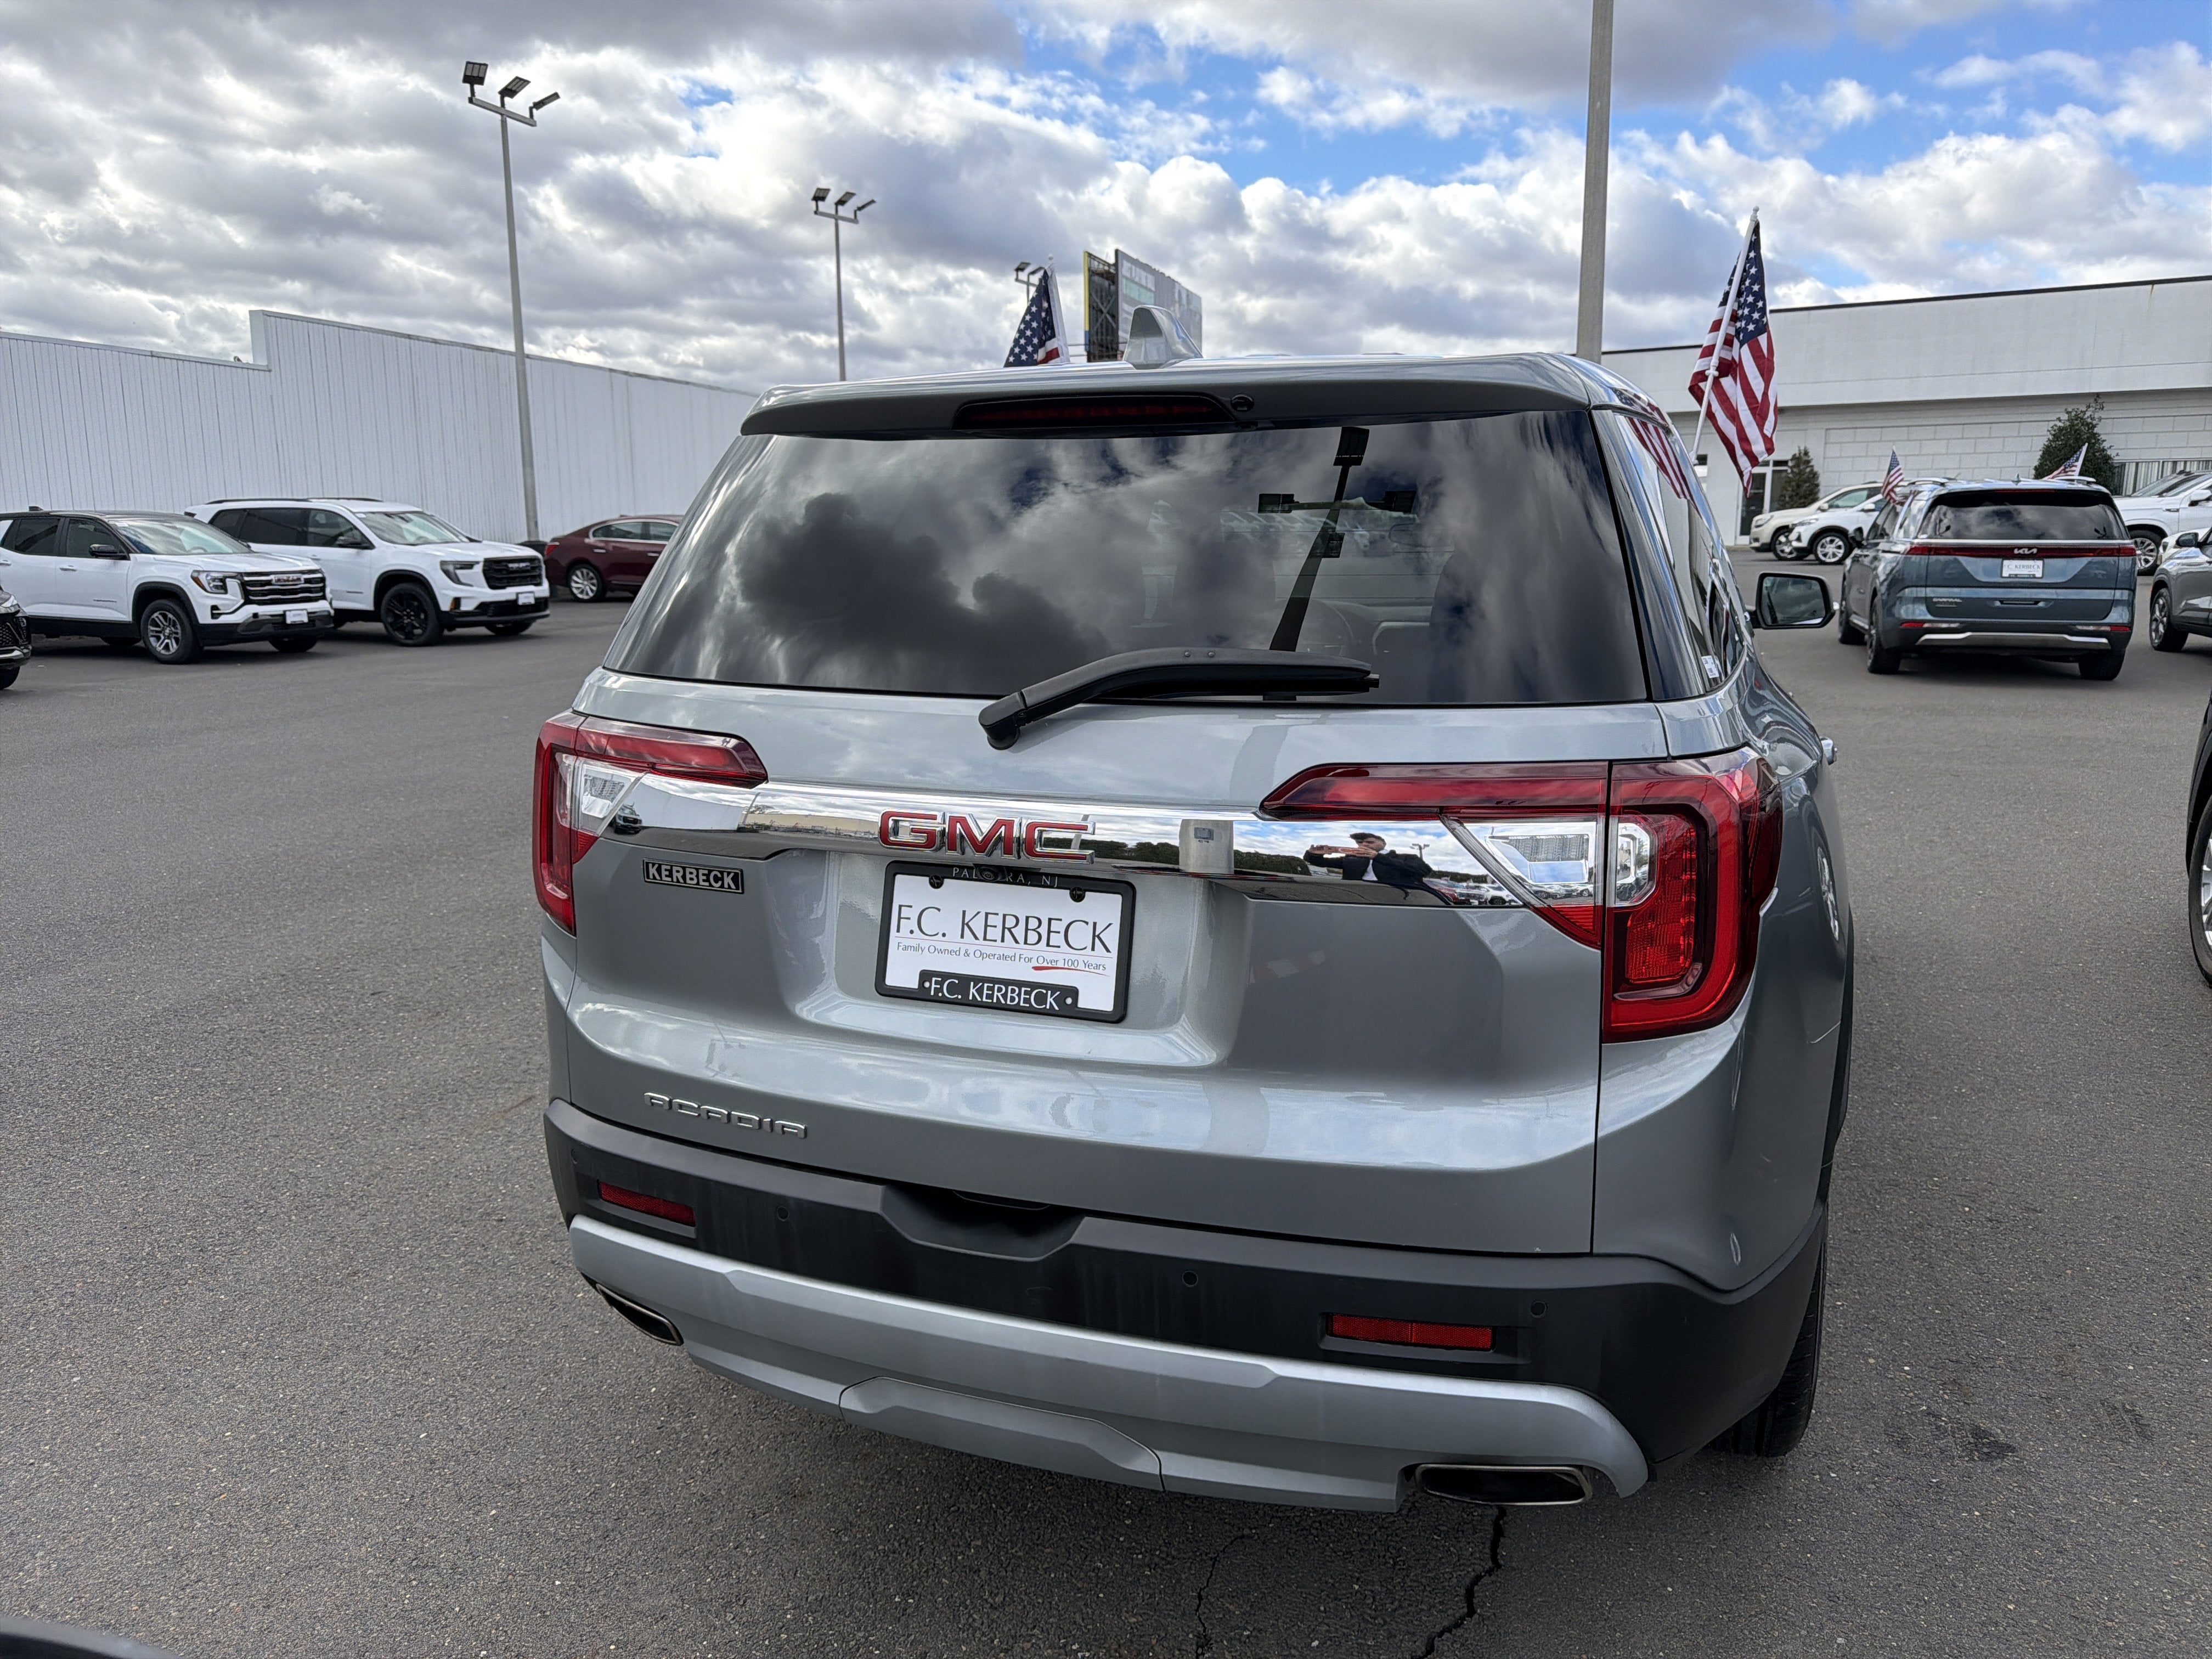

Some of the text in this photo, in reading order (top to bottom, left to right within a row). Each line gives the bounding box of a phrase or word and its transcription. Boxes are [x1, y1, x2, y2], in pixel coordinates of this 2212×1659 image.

[878, 809, 1096, 864] GMC
[648, 863, 736, 889] KERBECK
[952, 867, 1059, 888] PALRA, NJ
[895, 904, 1114, 953] F.C. KERBECK
[897, 942, 1107, 971] Family Owned & Operated For Over 100 Years
[930, 977, 1060, 1011] F.C. KERBECK
[644, 1092, 808, 1138] ACADIA
